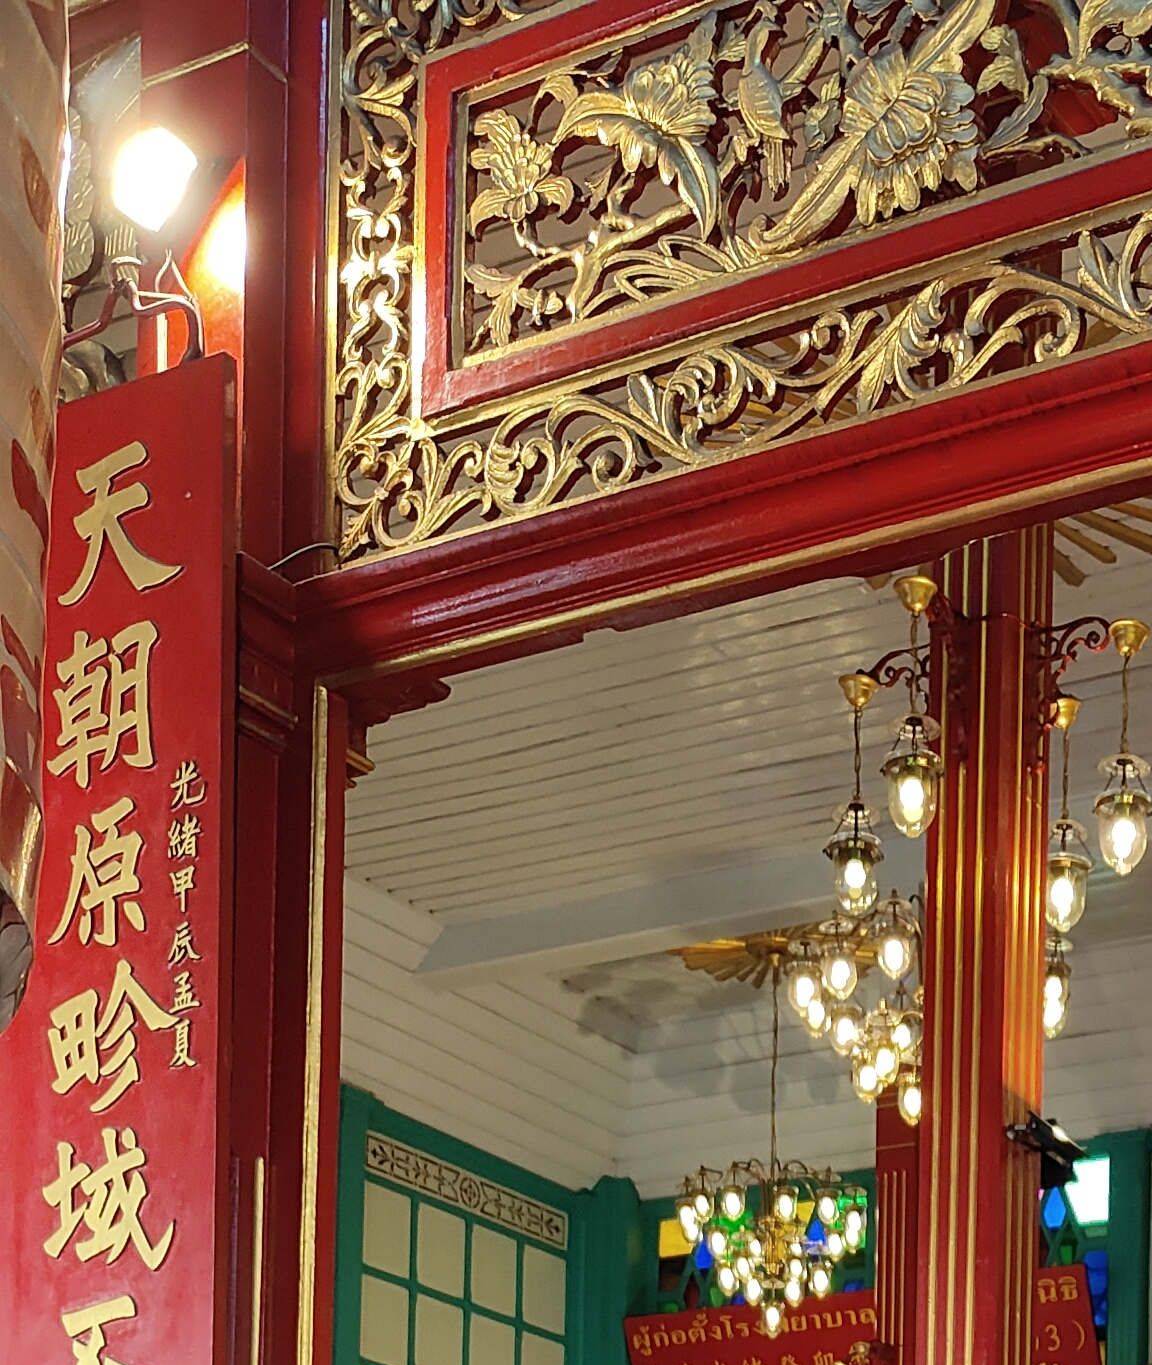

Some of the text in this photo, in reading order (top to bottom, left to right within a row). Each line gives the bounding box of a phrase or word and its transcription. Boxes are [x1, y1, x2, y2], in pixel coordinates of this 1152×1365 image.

[166, 760, 207, 1070] 光緒甲辰孟夏
